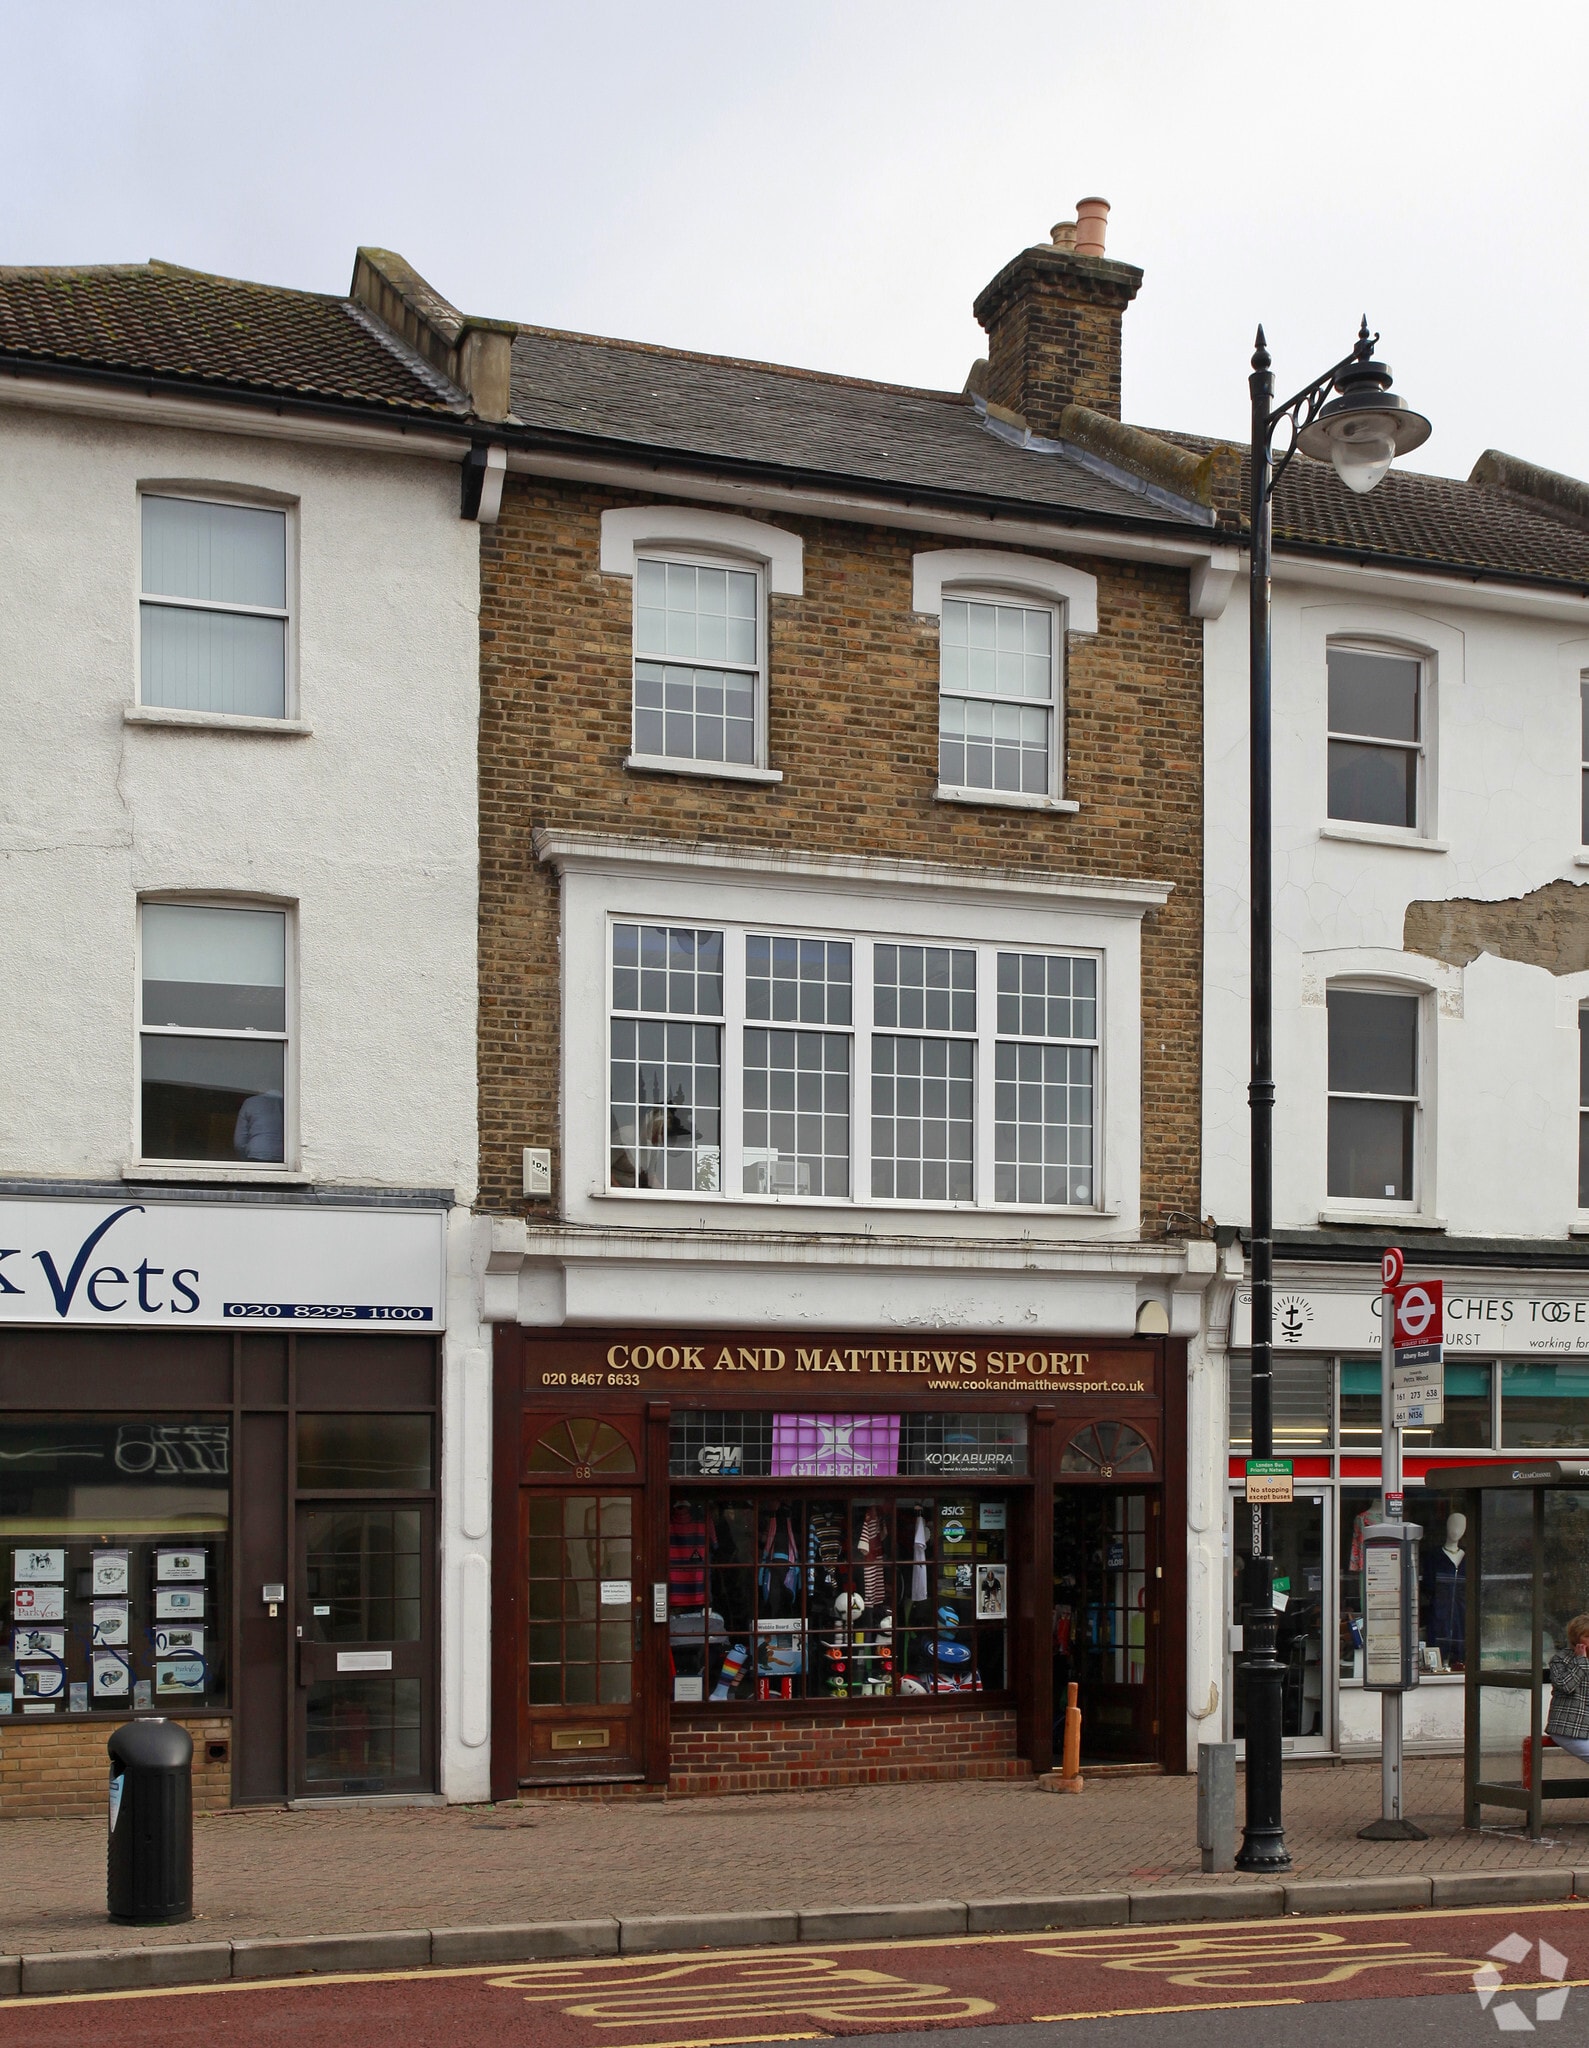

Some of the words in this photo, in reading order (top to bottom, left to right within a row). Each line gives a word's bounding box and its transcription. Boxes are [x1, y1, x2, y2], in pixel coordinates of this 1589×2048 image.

[1384, 1255, 1396, 1282] D
[229, 1304, 282, 1317] 020
[293, 1305, 357, 1318] 8295
[368, 1306, 425, 1320] 1100
[1371, 1297, 1514, 1321] CCHES
[1529, 1337, 1571, 1351] working
[606, 1345, 706, 1370] COOK
[713, 1347, 786, 1371] AND
[795, 1348, 977, 1374] MATTHEWS
[987, 1351, 1089, 1375] SPORT
[1417, 1350, 1430, 1358] Road
[542, 1373, 567, 1385] 020
[571, 1373, 604, 1385] 8467
[607, 1373, 640, 1386] 6633
[928, 1378, 1145, 1394] www.cookandmatthewssport.co.uk
[1396, 1393, 1406, 1401] 161
[1410, 1391, 1421, 1399] 273
[1426, 1389, 1438, 1397] 638
[1396, 1412, 1406, 1420] 661
[1408, 1411, 1423, 1419] N136
[925, 1453, 1014, 1464] KOOKABURRA
[575, 1466, 591, 1479] 68
[791, 1463, 878, 1477] GILBERT
[1100, 1466, 1113, 1478] 68
